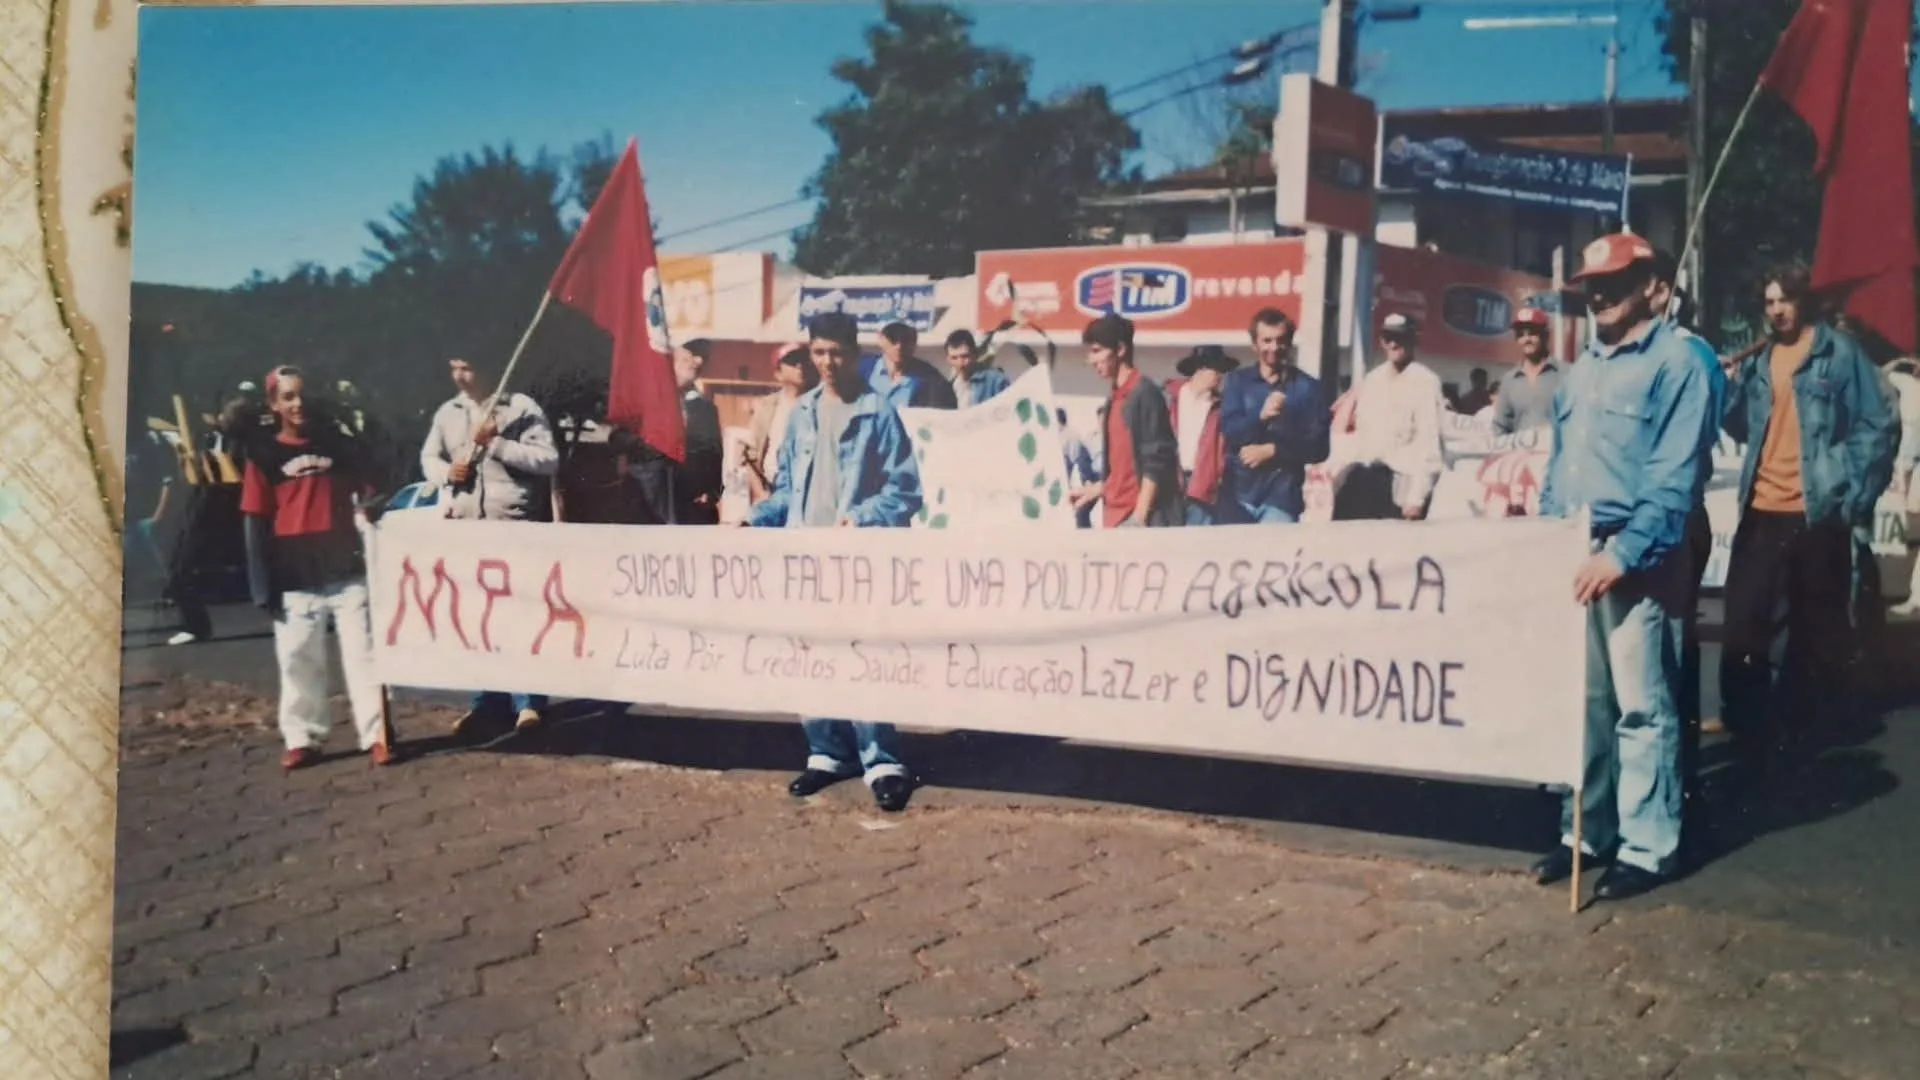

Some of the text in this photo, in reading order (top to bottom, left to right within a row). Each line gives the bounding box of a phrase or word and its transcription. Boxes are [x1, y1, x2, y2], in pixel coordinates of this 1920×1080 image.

[1554, 157, 1568, 183] 2
[1120, 272, 1178, 306] TIM
[1476, 297, 1507, 329] TIM
[613, 553, 696, 599] SURGIU
[712, 554, 764, 600] POR
[783, 554, 873, 604] FALTA
[891, 556, 923, 606] DE
[945, 557, 1005, 609] UMA
[615, 627, 670, 670] Luta
[945, 642, 1074, 697] Educação
[1192, 669, 1209, 703] e
